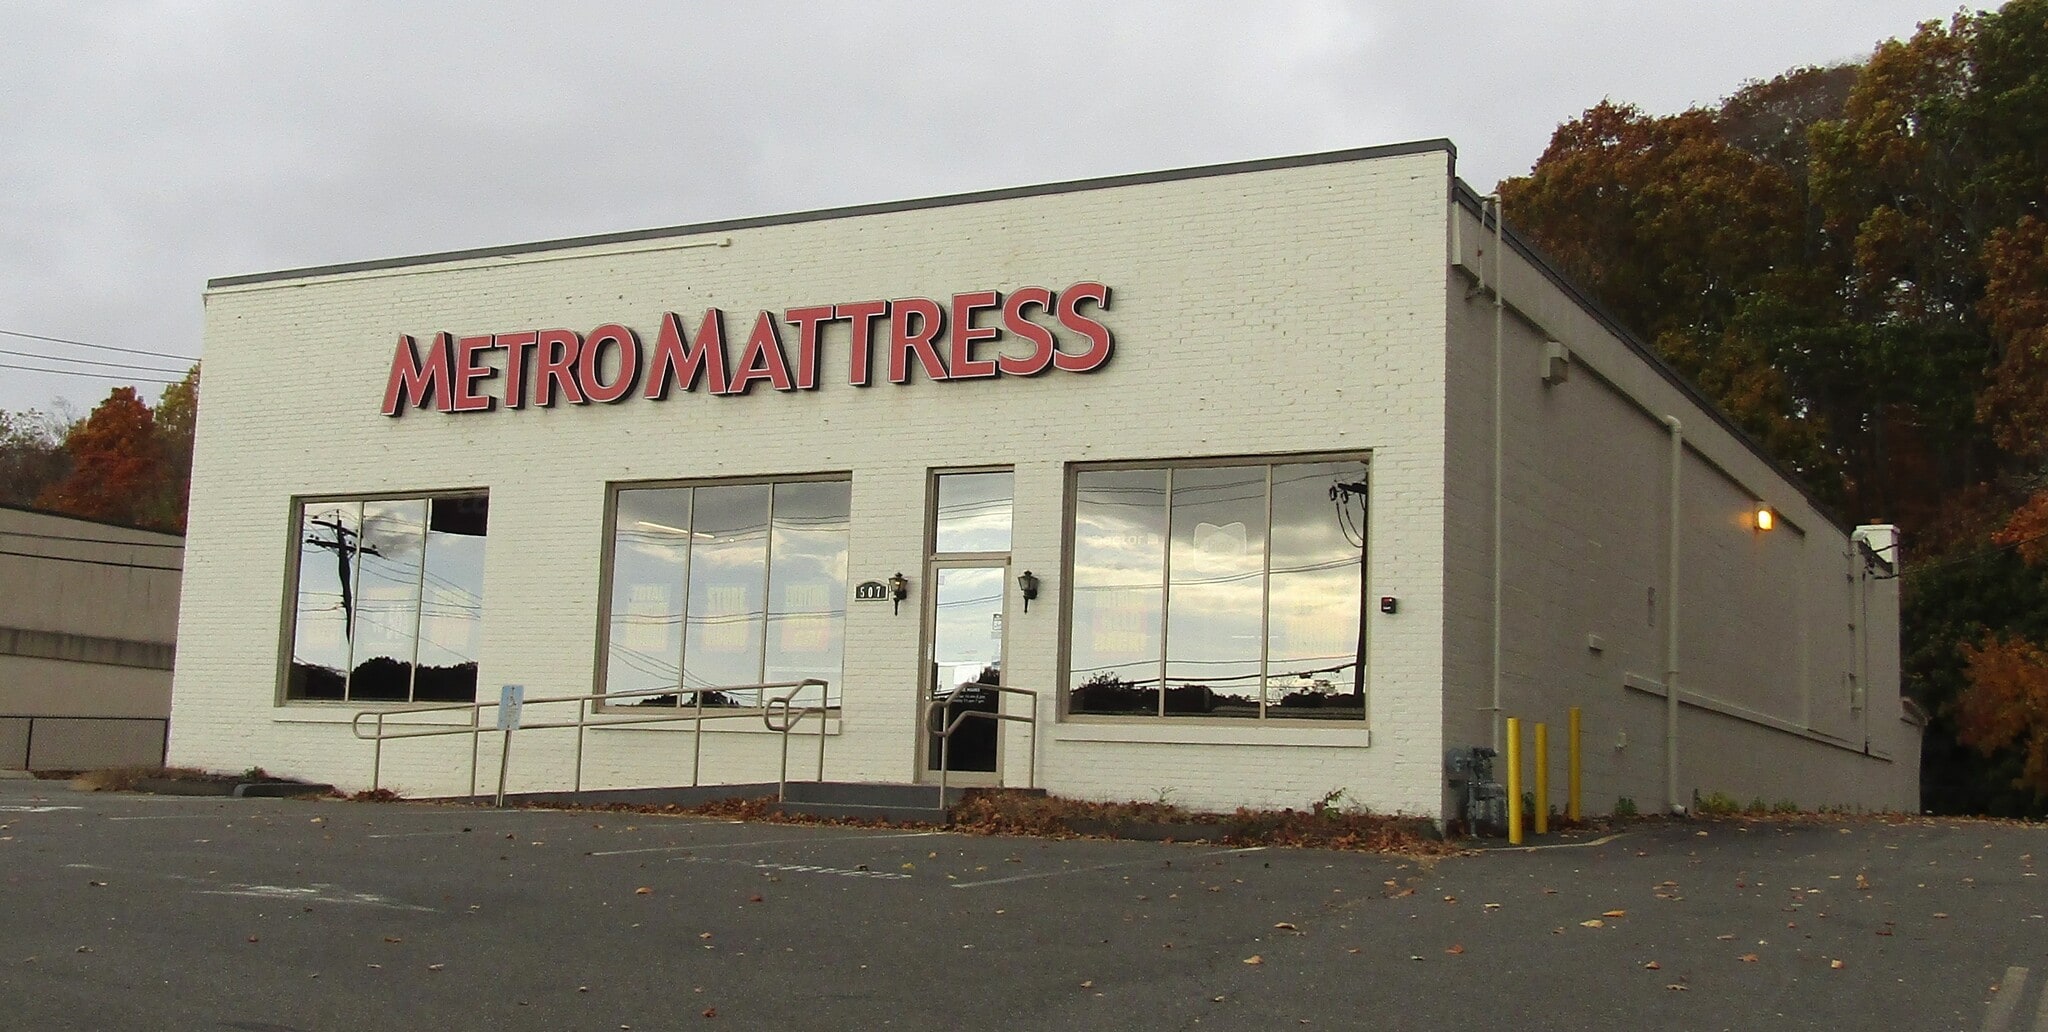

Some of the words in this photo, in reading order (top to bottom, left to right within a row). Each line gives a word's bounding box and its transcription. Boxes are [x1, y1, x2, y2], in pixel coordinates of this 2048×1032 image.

[381, 322, 641, 416] METRO
[644, 281, 1115, 400] MATTRESS
[859, 586, 881, 598] 507
